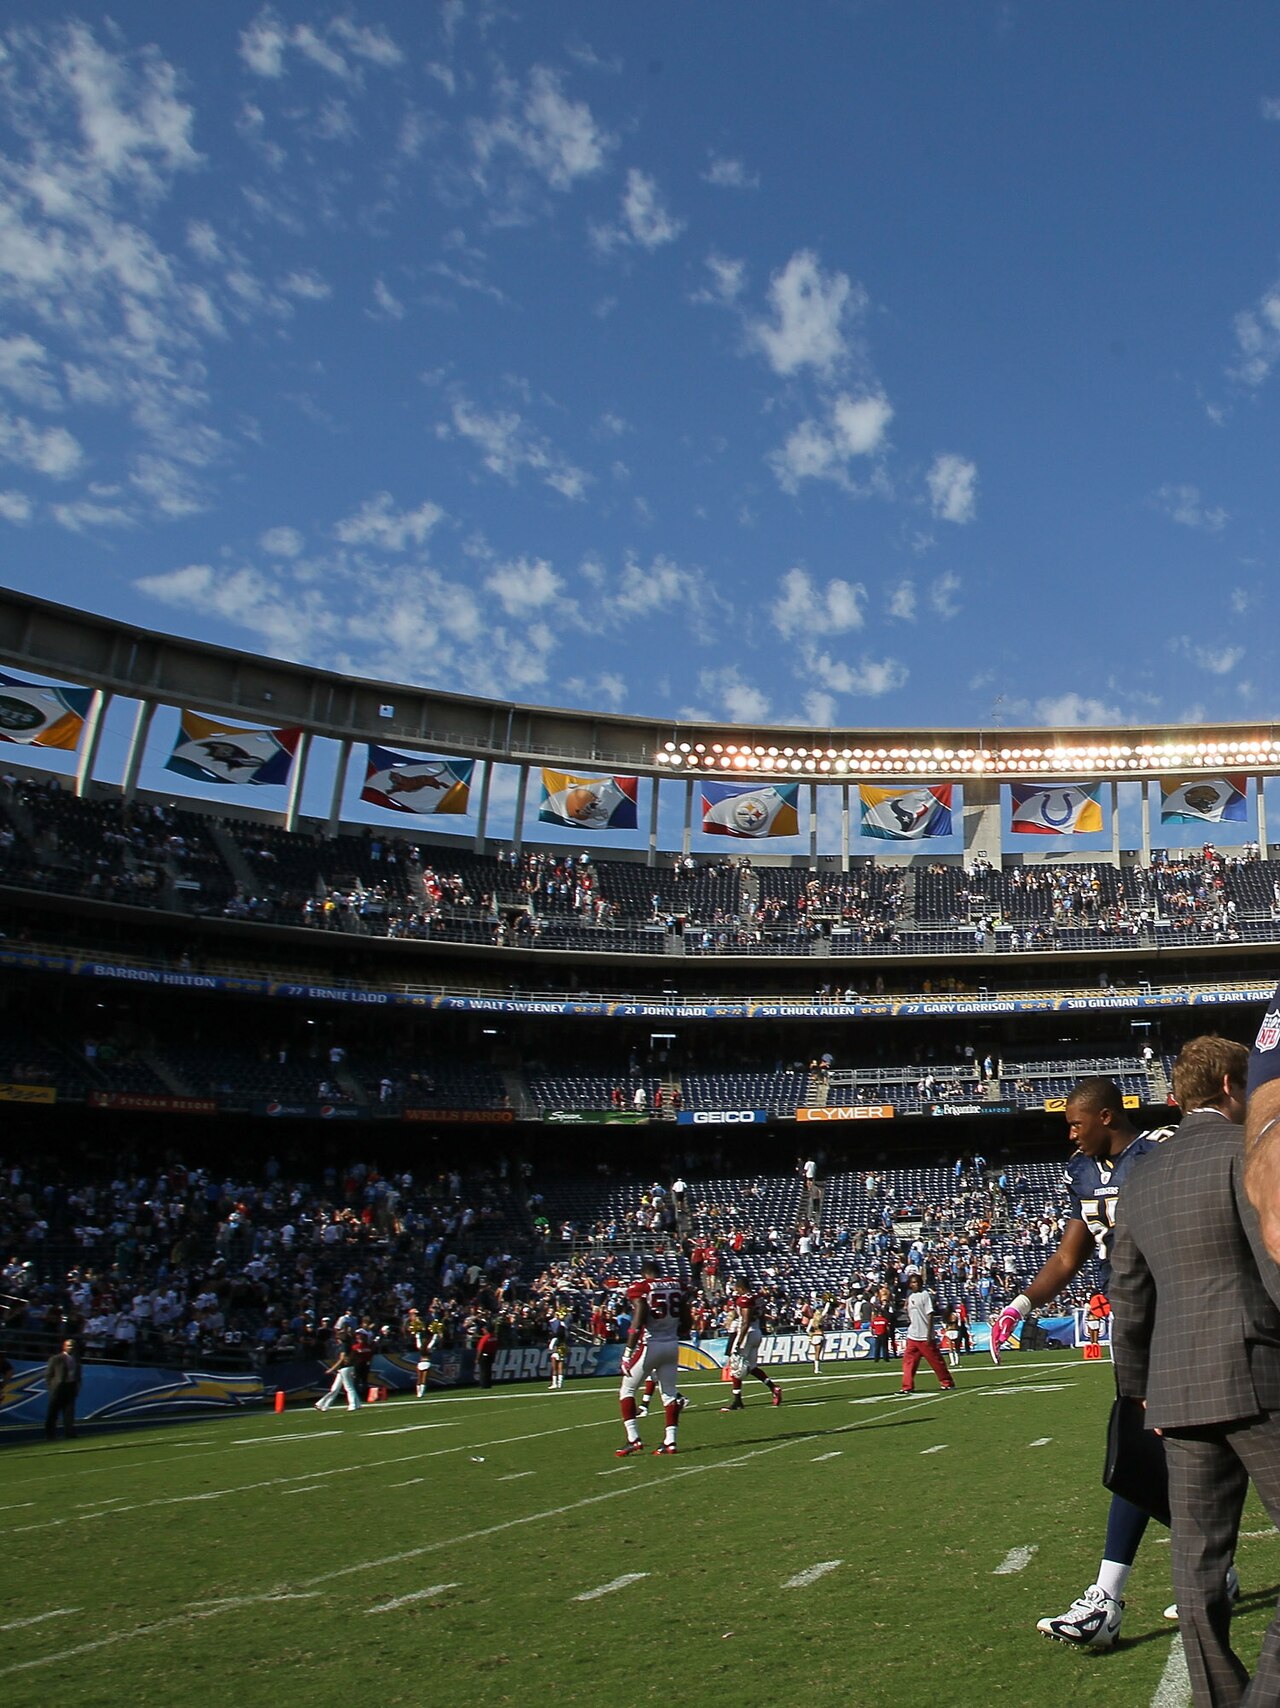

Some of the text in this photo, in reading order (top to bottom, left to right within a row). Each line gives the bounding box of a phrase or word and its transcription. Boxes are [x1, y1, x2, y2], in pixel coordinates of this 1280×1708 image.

[94, 965, 160, 983] BARRON
[163, 973, 216, 988] HILTON
[308, 987, 350, 1002] ERNIE
[351, 991, 388, 1004] LADD
[1201, 993, 1216, 1002] 86
[1218, 992, 1246, 1002] EARL
[449, 999, 465, 1008] 78
[469, 999, 505, 1010] WALT
[506, 1002, 567, 1014] SWEENEY
[907, 1005, 919, 1013] 27
[923, 1004, 956, 1013] GARY
[956, 1002, 1015, 1013] GARRISON
[1067, 999, 1088, 1009] SID
[1088, 997, 1139, 1009] GILLMAN
[624, 1006, 637, 1015] 21
[640, 1006, 674, 1017] JOHN
[676, 1006, 708, 1017] HADL
[762, 1007, 777, 1016] 50
[780, 1006, 819, 1016] CHUCK
[819, 1006, 855, 1016] ALLEN
[1260, 1029, 1277, 1046] NFL
[406, 1109, 513, 1122] WELLS FARGO
[693, 1110, 755, 1124] GEICO
[807, 1106, 884, 1121] CYMER
[1086, 1345, 1100, 1359] 20
